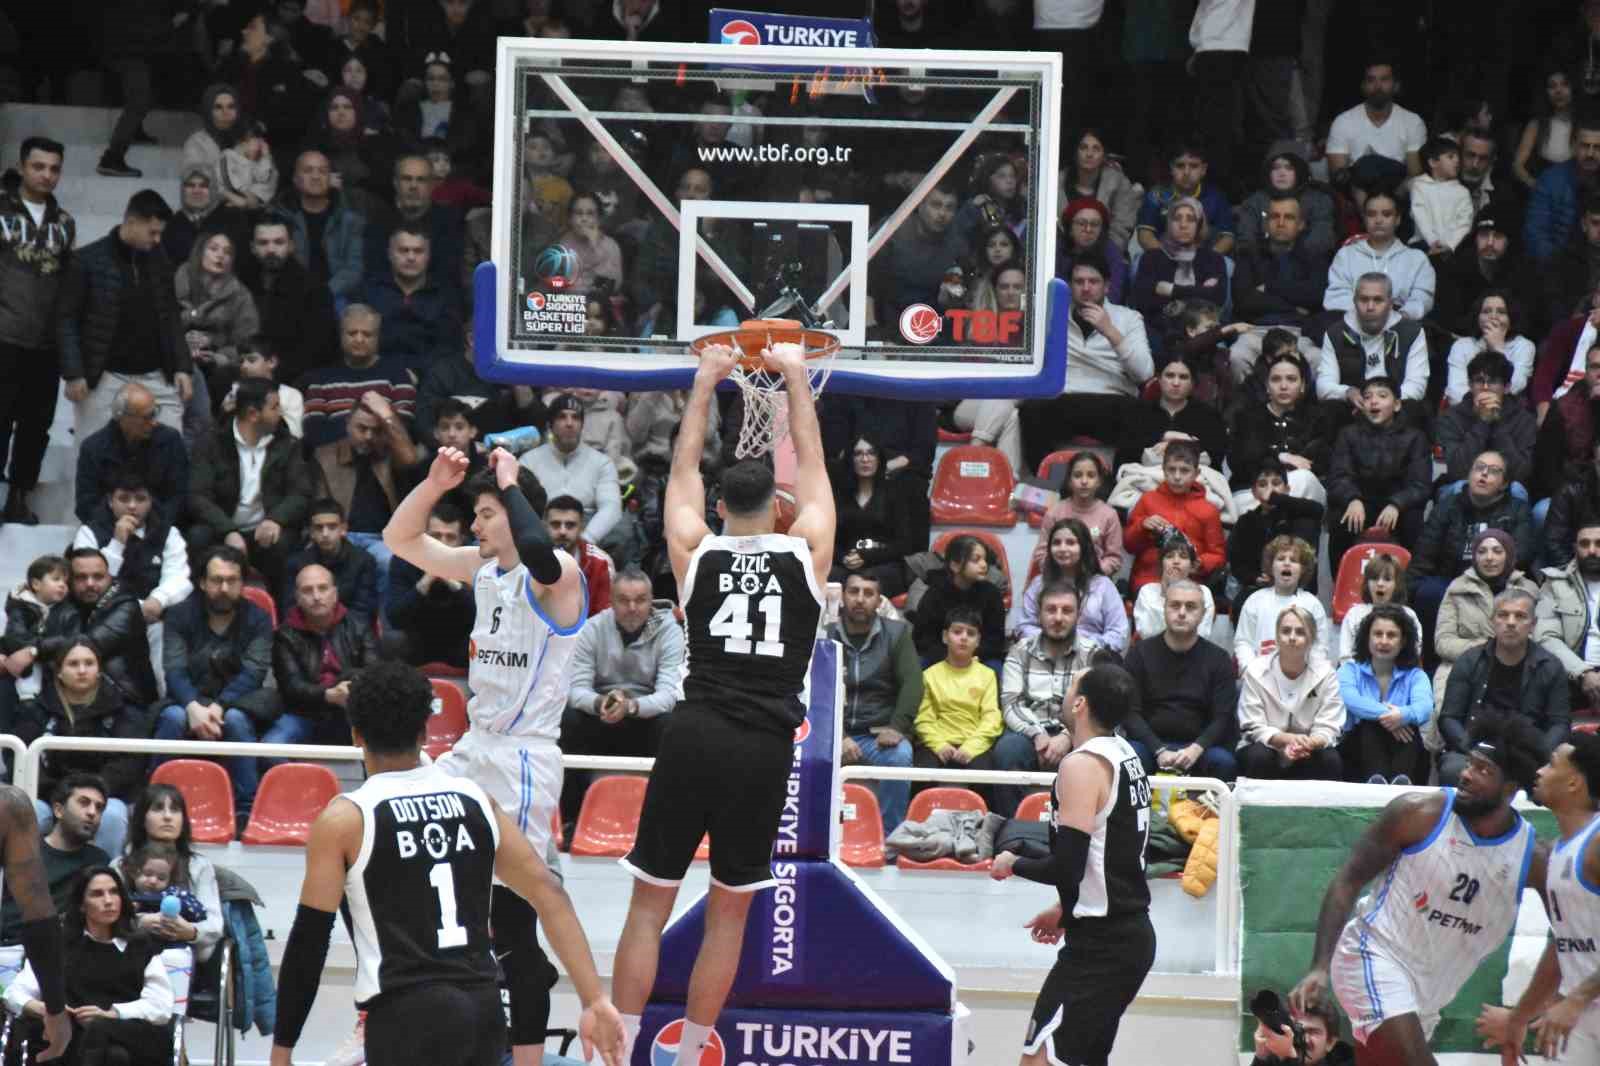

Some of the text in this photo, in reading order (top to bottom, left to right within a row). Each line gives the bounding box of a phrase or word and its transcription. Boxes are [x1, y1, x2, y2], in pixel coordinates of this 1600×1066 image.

[697, 143, 853, 166] www.tbf.org.tr
[944, 309, 1024, 344] TBF
[489, 606, 503, 635] 6
[708, 593, 785, 657] 41
[389, 793, 466, 823] DOTSON
[1449, 872, 1480, 905] 20
[429, 862, 468, 949] 1
